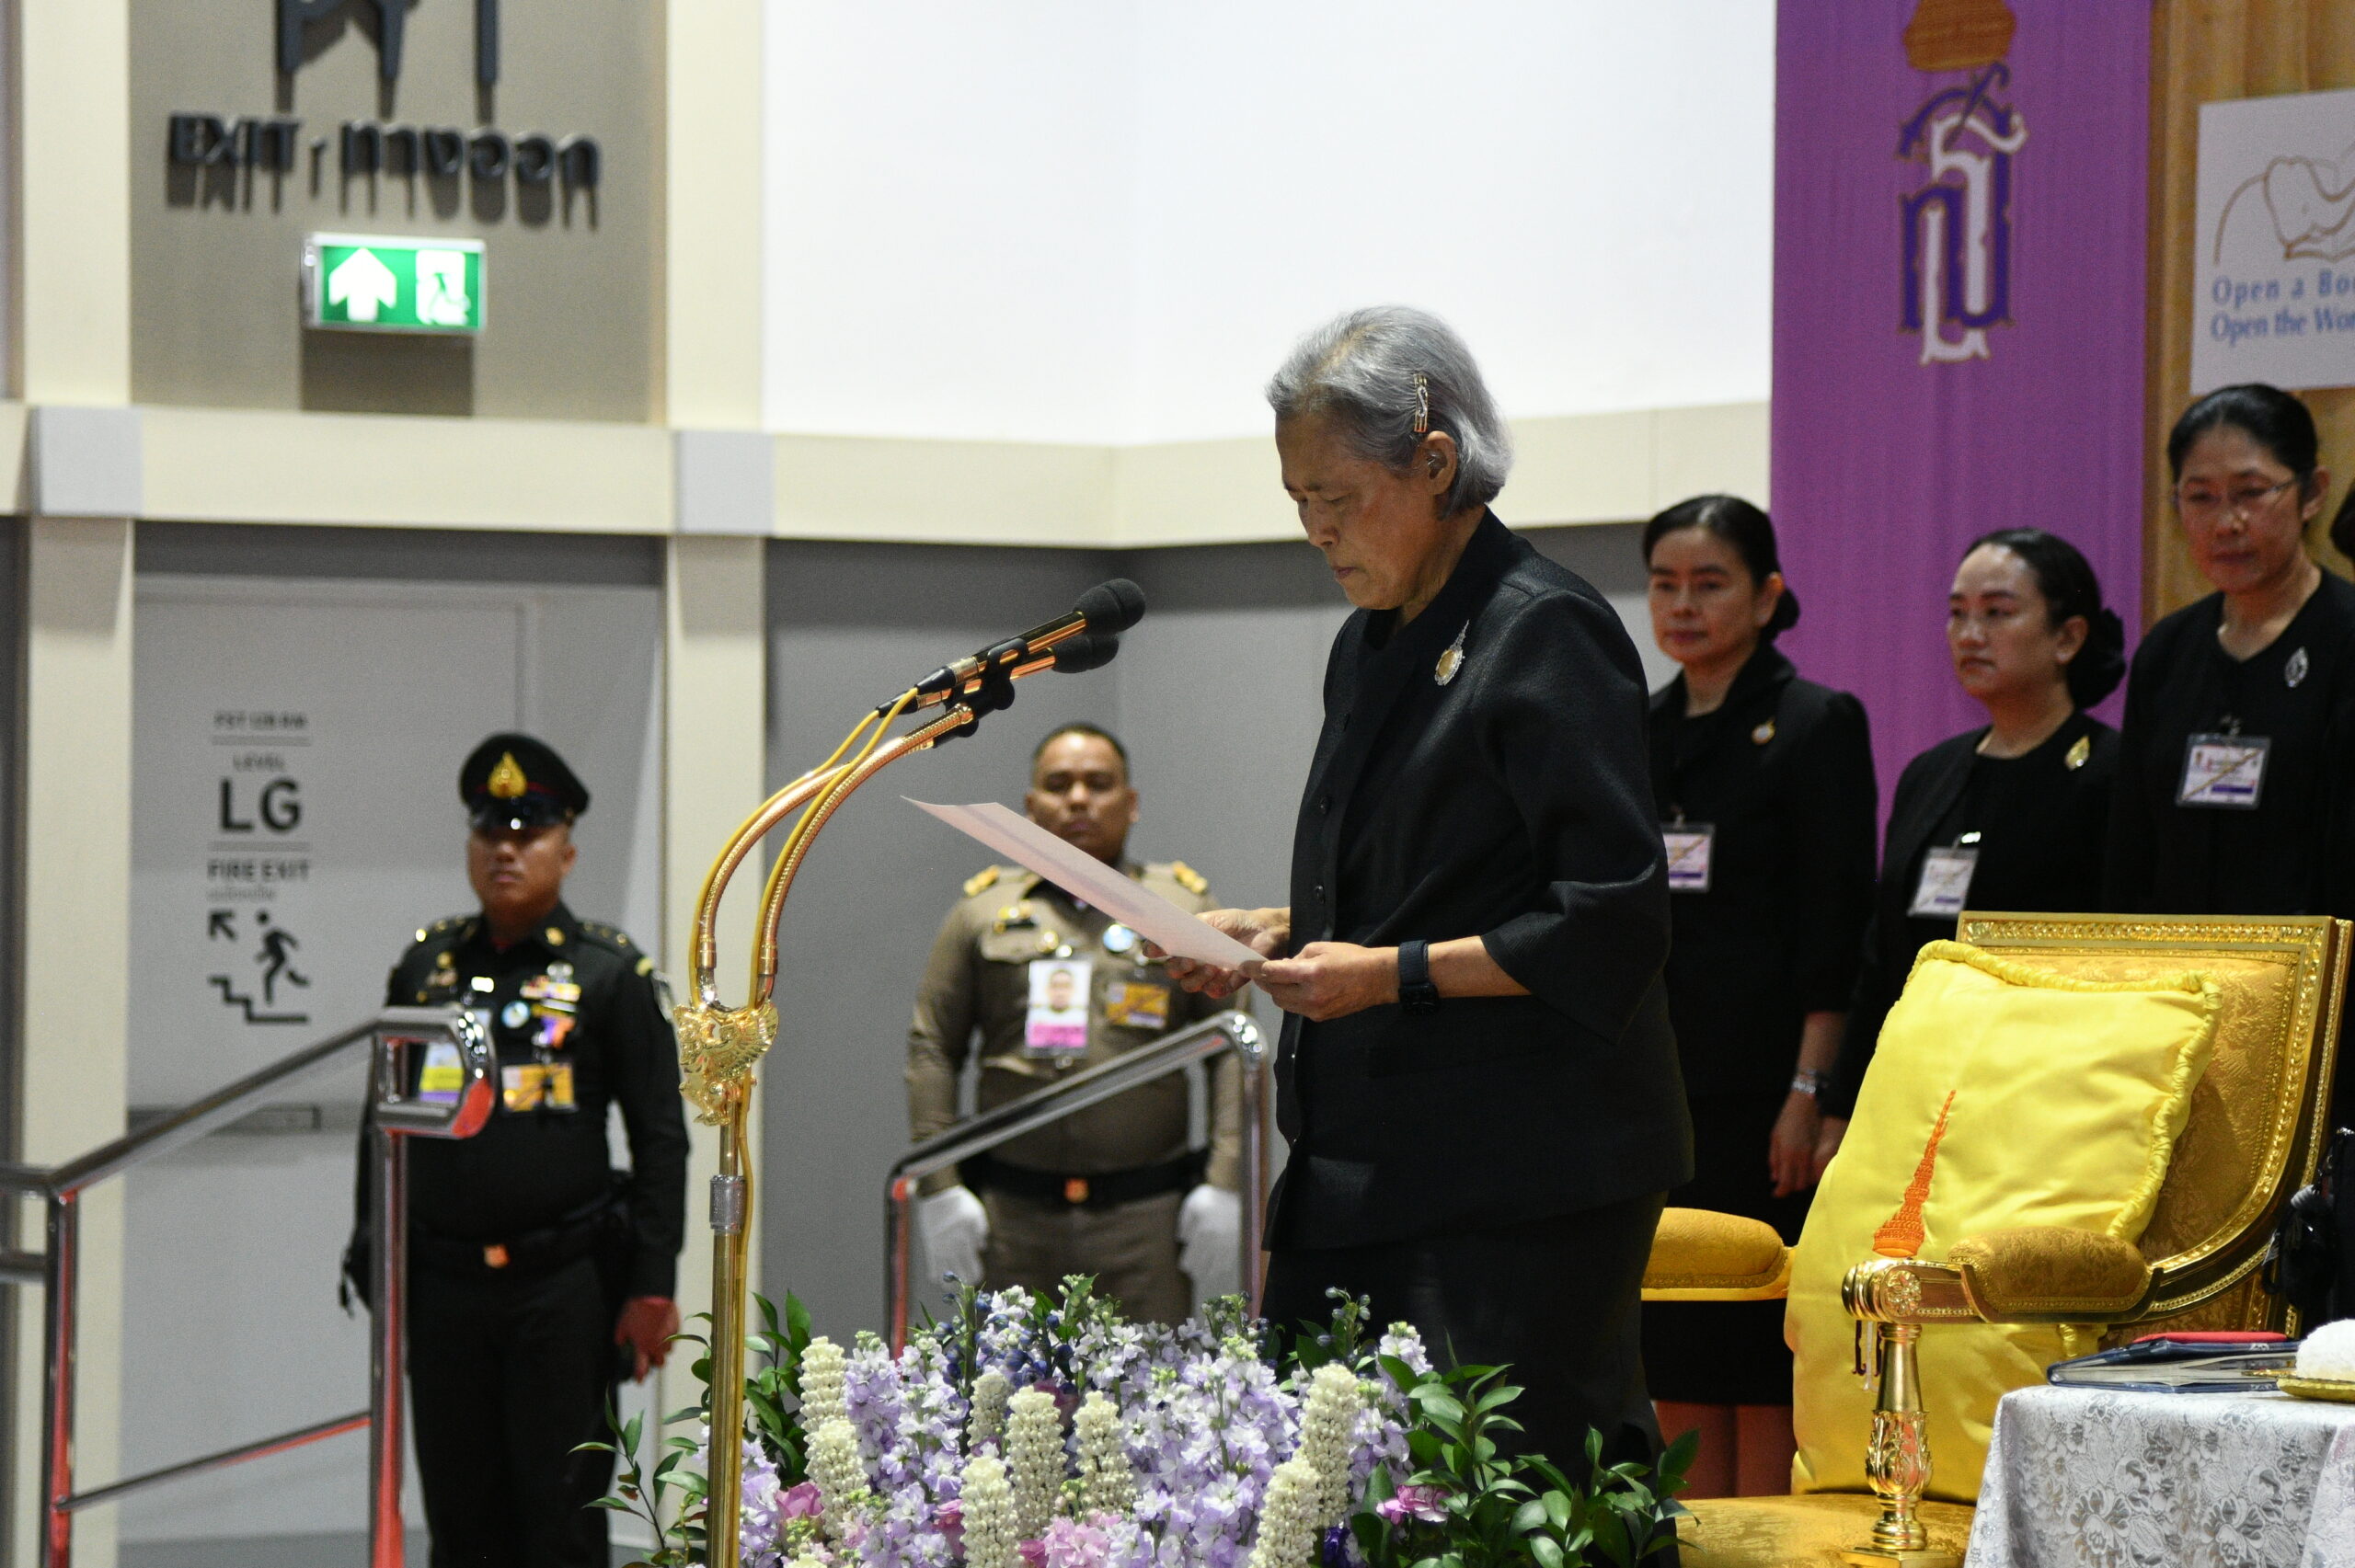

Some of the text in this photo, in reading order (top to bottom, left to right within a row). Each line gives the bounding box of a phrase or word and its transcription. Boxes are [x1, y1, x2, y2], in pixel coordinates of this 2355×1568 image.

[169, 113, 302, 173] EXIT
[339, 121, 599, 189] ทางออก
[2212, 269, 2355, 309] Open a Bo
[2211, 312, 2269, 347] Open
[2275, 308, 2307, 336] the
[220, 779, 302, 832] LG
[207, 860, 310, 881] FIRE EXIT
